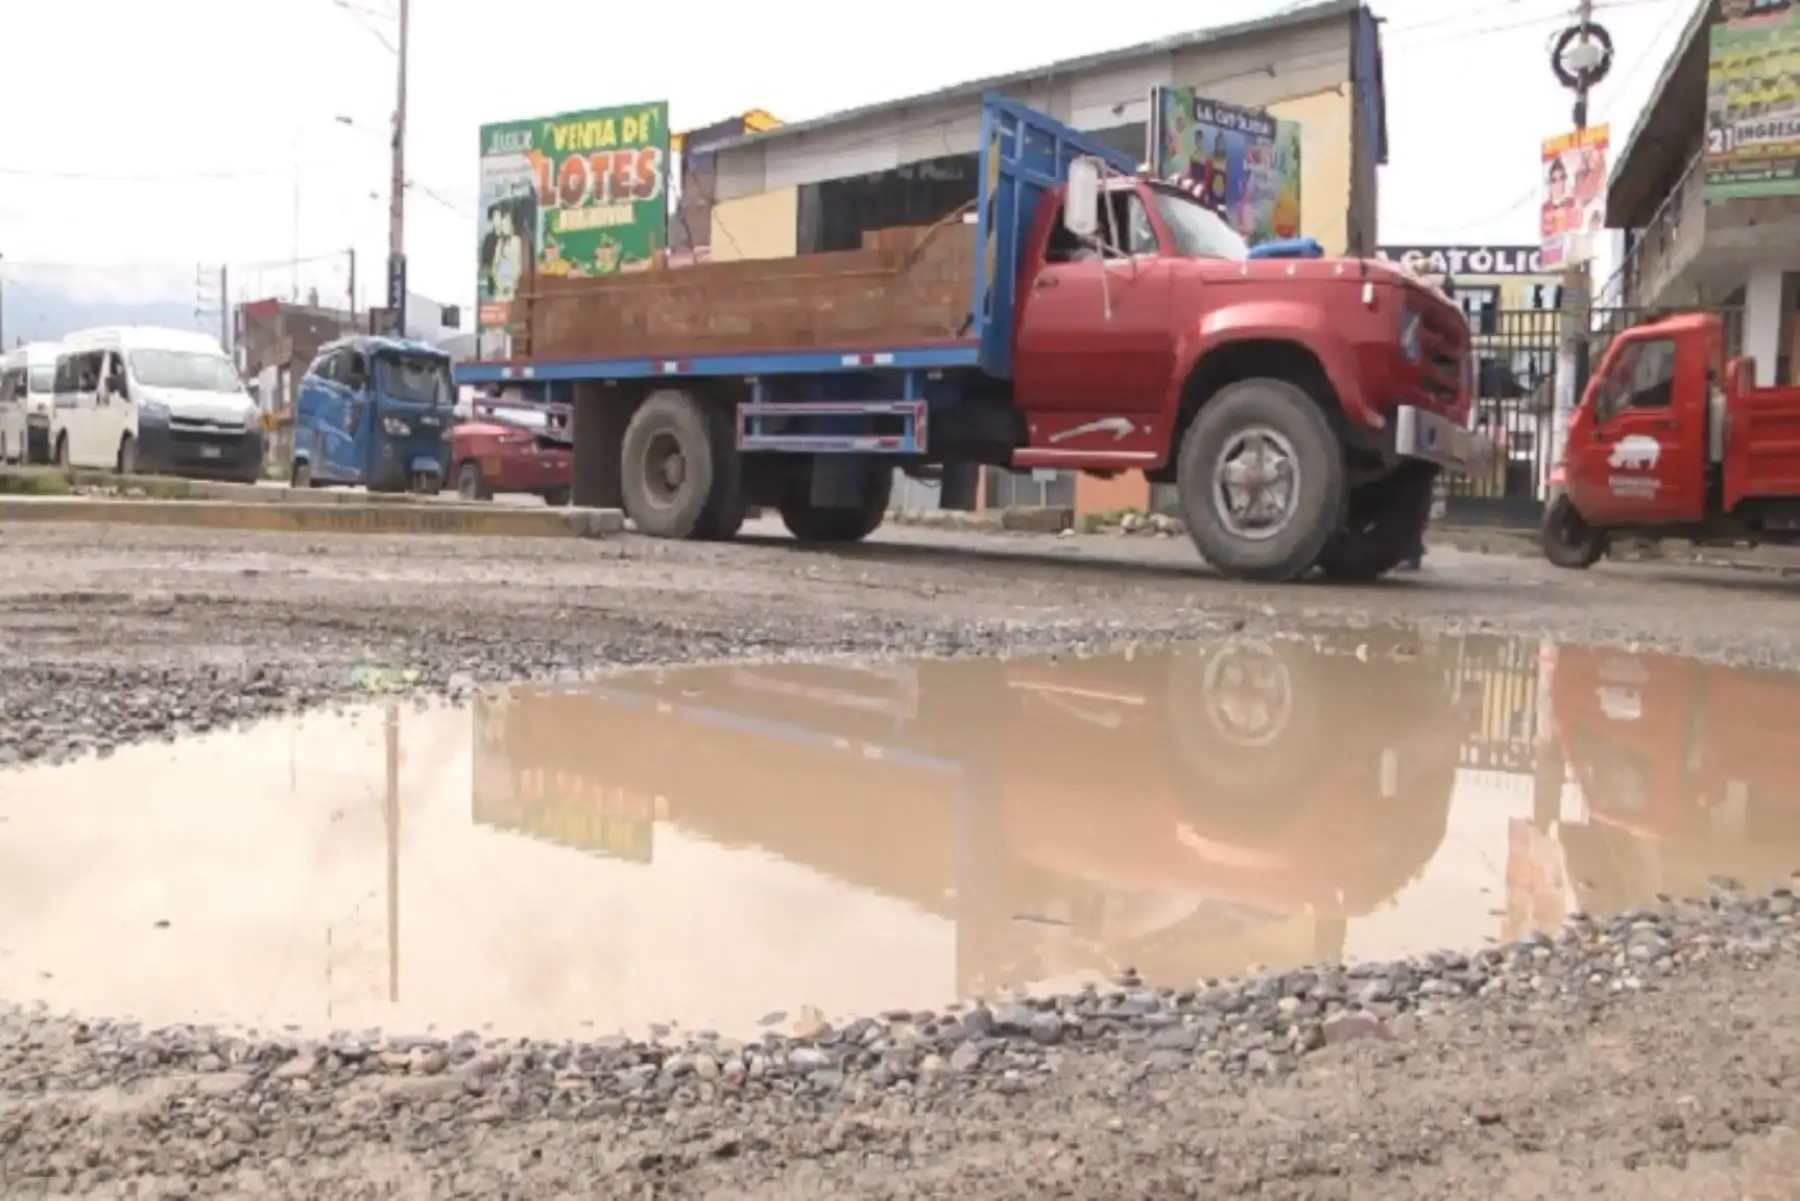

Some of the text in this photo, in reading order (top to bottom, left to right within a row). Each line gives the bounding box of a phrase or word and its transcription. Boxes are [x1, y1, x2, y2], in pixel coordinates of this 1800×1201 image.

[1197, 103, 1213, 121] LA
[553, 118, 616, 150] VENTA
[621, 111, 649, 144] DE
[1708, 128, 1734, 153] 21
[538, 146, 662, 208] LOTES
[1401, 246, 1542, 273] CATÓLIC
